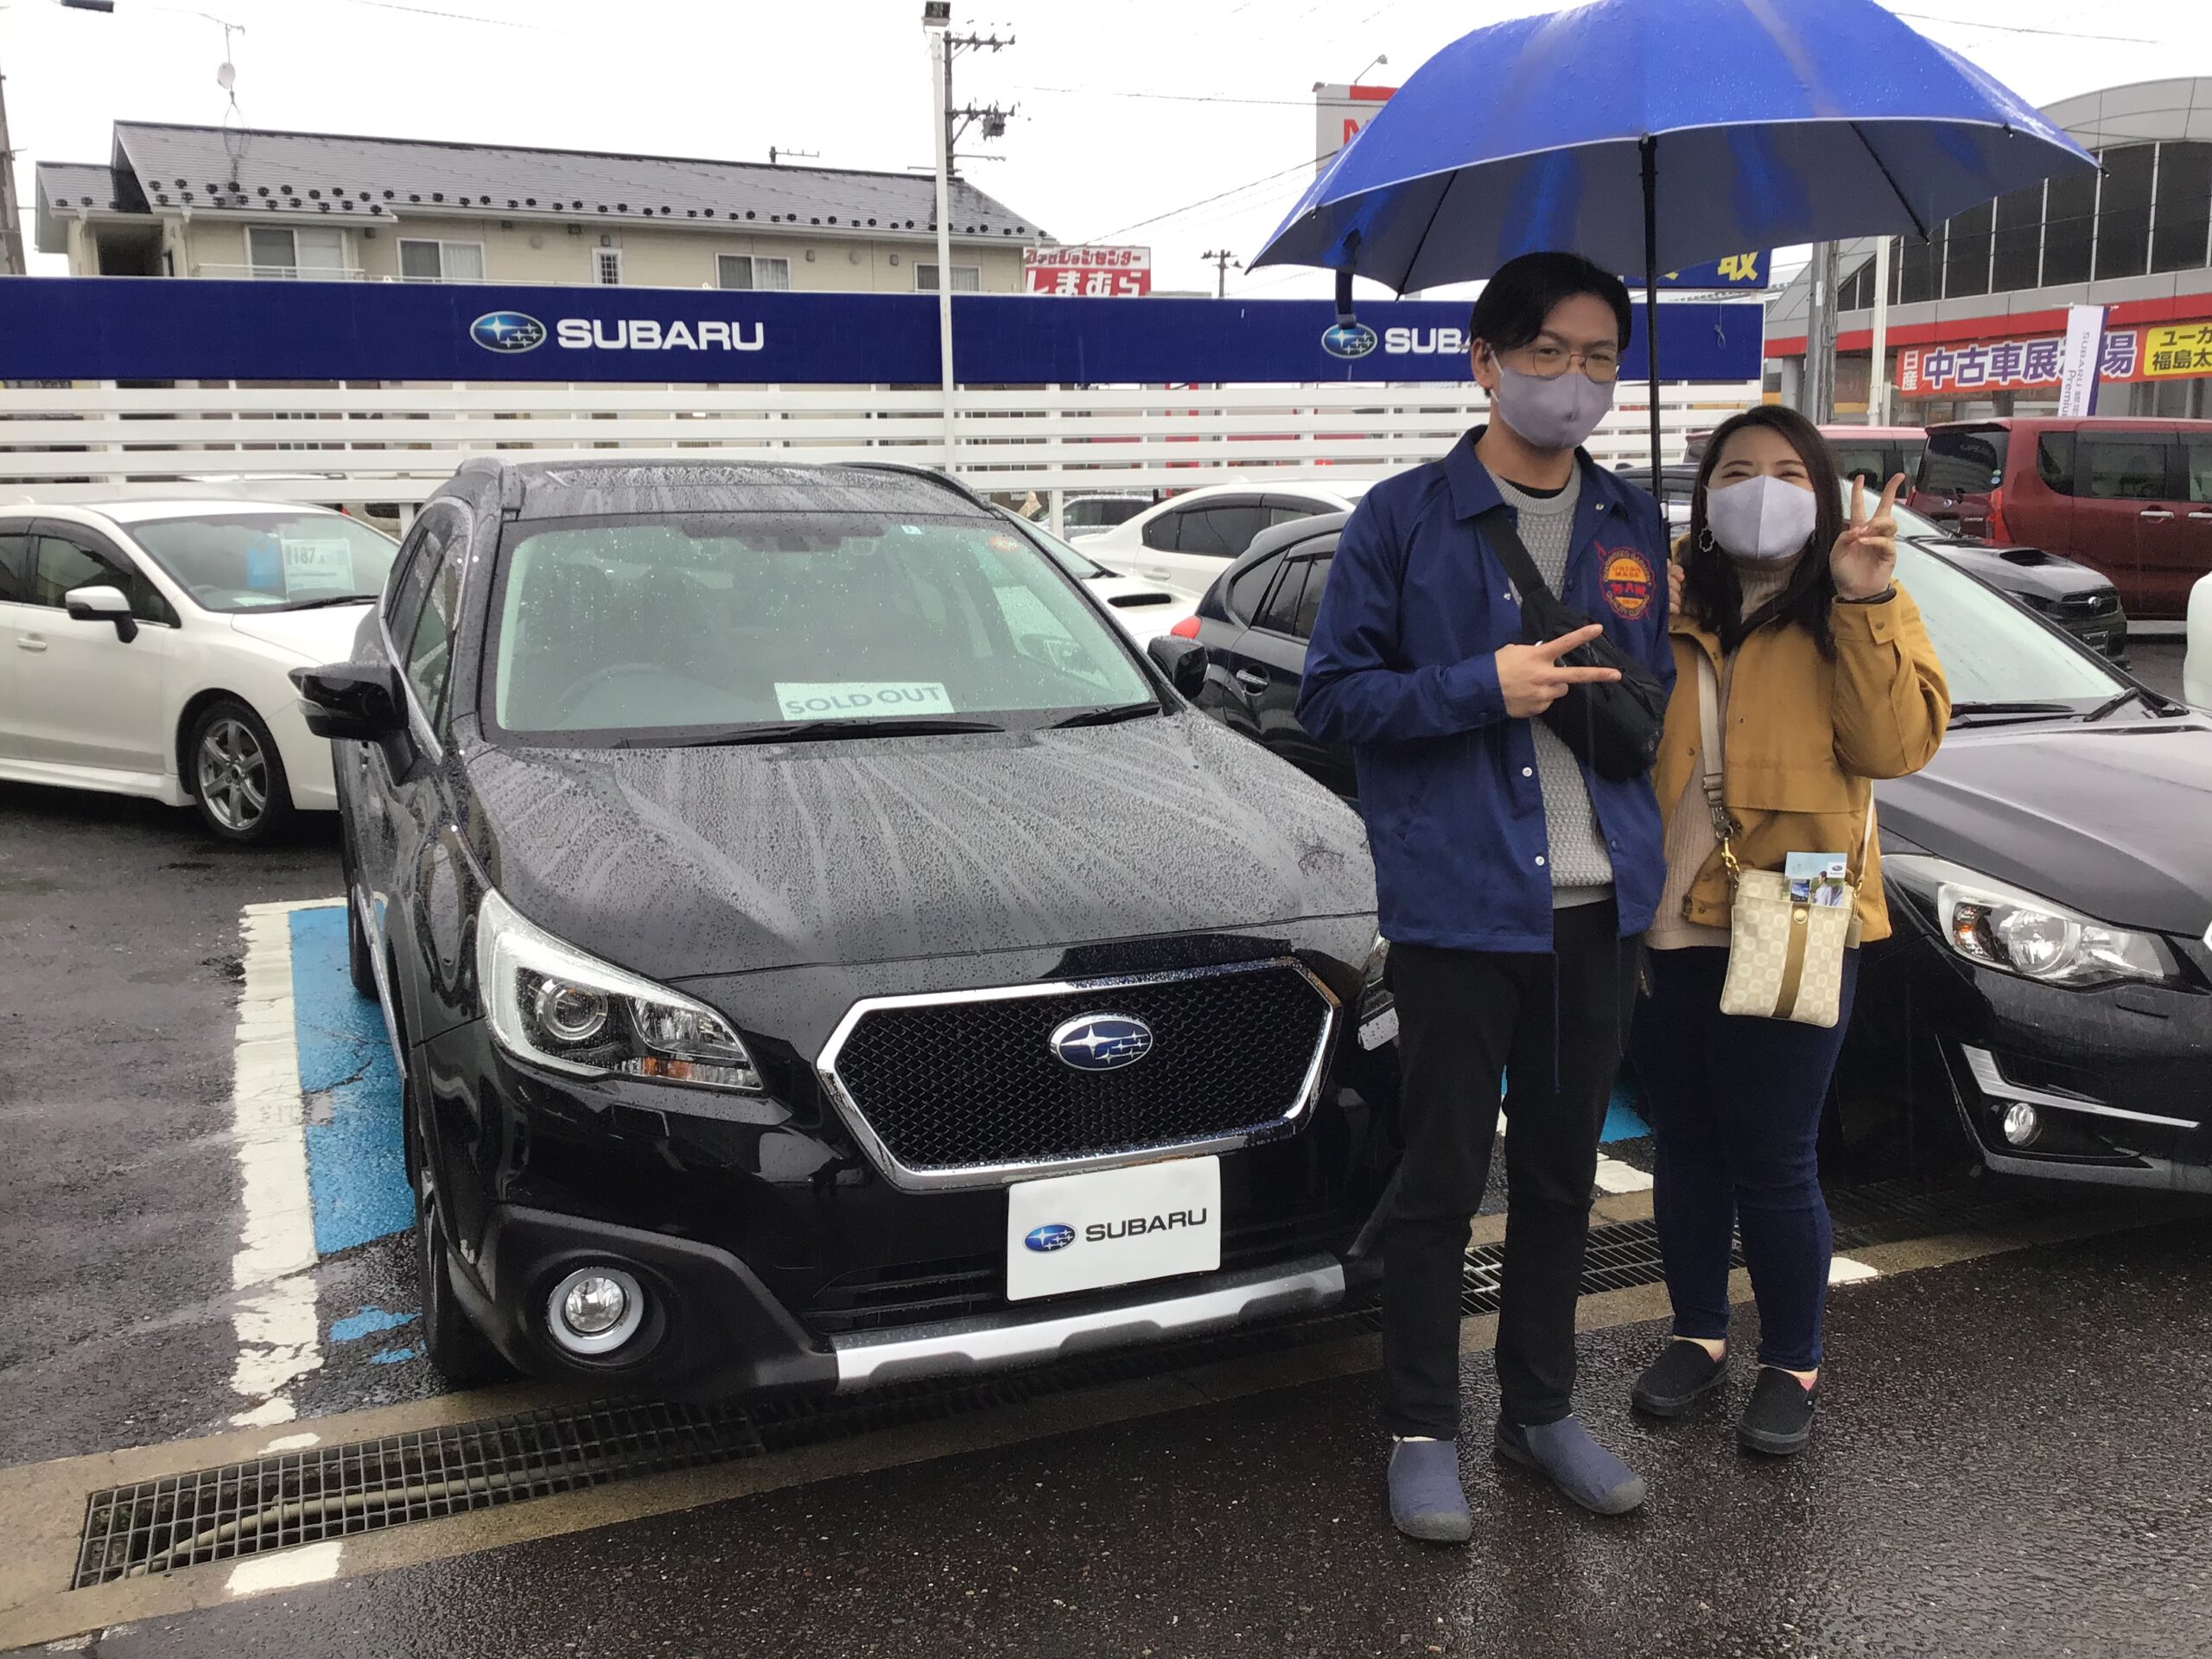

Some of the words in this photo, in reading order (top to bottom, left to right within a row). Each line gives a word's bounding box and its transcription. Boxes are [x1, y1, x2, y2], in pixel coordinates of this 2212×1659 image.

[1026, 270, 1141, 296] しまむら
[556, 319, 765, 351] SUBARU
[1385, 327, 1470, 353] SUB
[1903, 349, 1919, 391] 日産
[1923, 331, 2137, 389] 中古車展場
[2075, 331, 2090, 387] SUBARU
[2152, 348, 2212, 372] 福島太
[785, 694, 873, 715] SOLD
[877, 687, 941, 703] OUT
[1085, 1208, 1207, 1243] SUBARU
